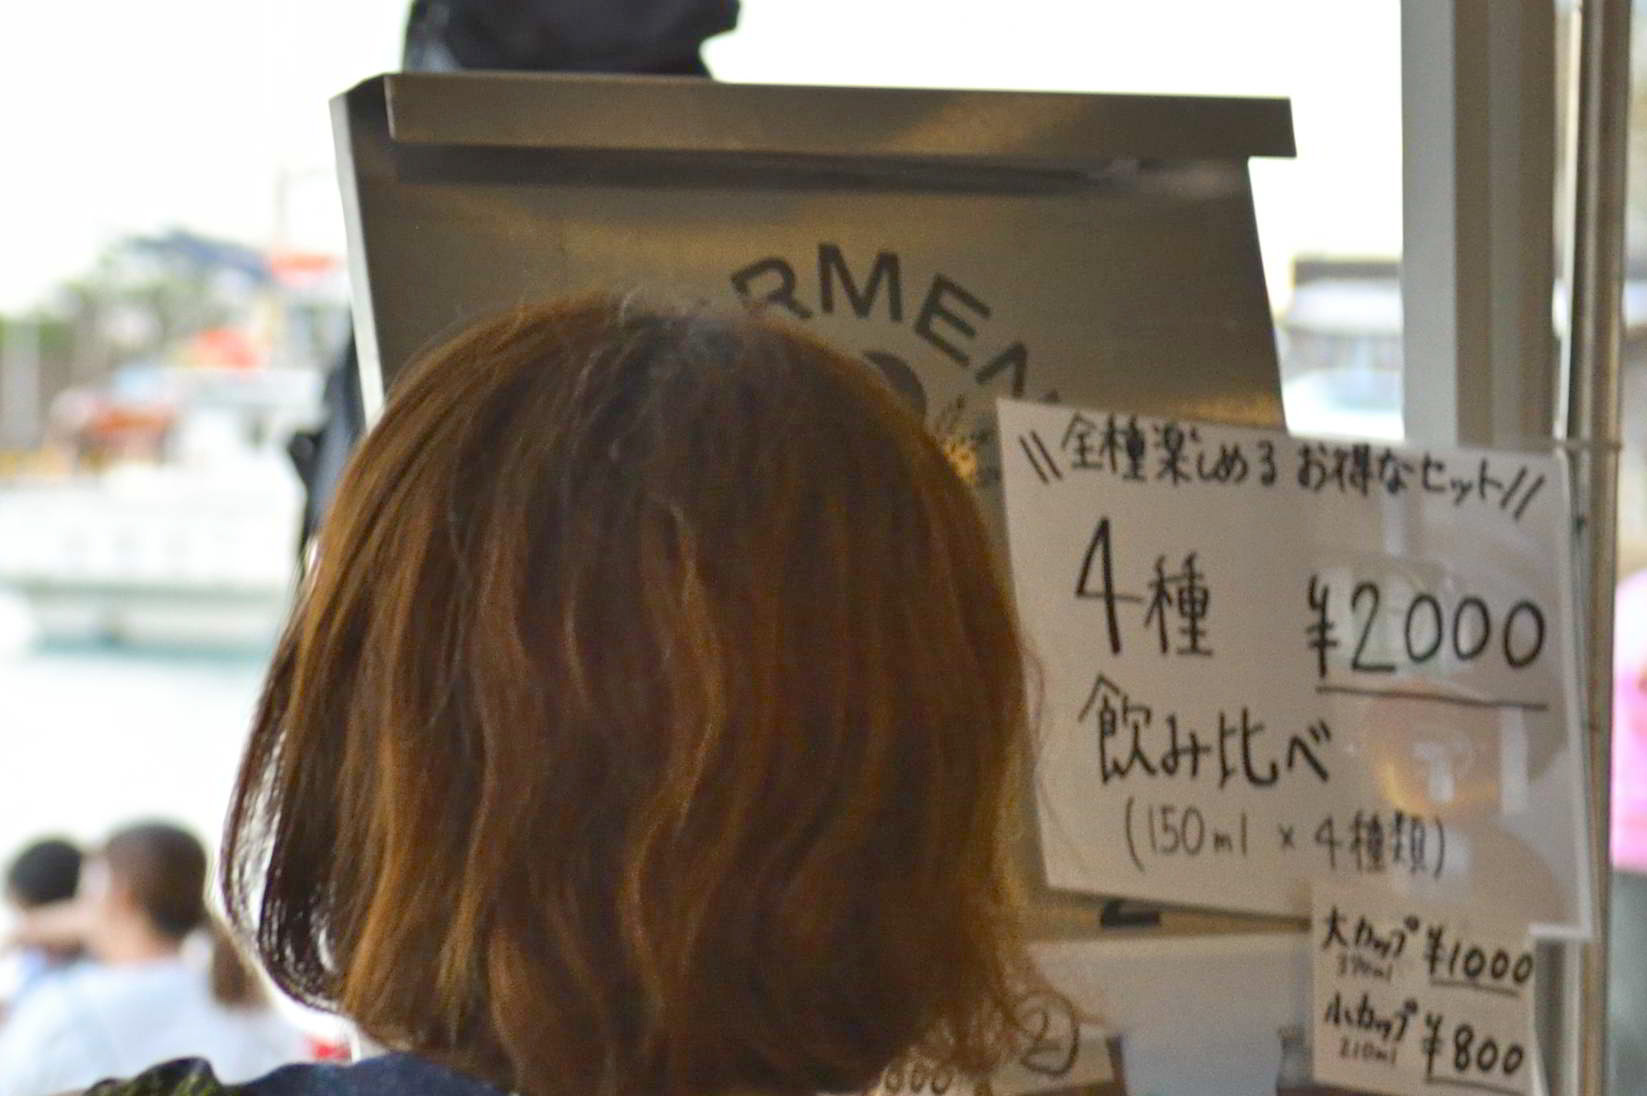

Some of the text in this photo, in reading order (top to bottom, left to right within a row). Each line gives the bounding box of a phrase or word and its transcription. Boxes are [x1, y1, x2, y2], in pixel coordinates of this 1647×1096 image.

[1074, 514, 1546, 680] 4種 ¥2000
[1078, 673, 1331, 788] 飲み比べ
[1322, 904, 1420, 959] 大カップ
[1424, 924, 1534, 985] ¥1000
[1423, 1011, 1524, 1077] ¥800
